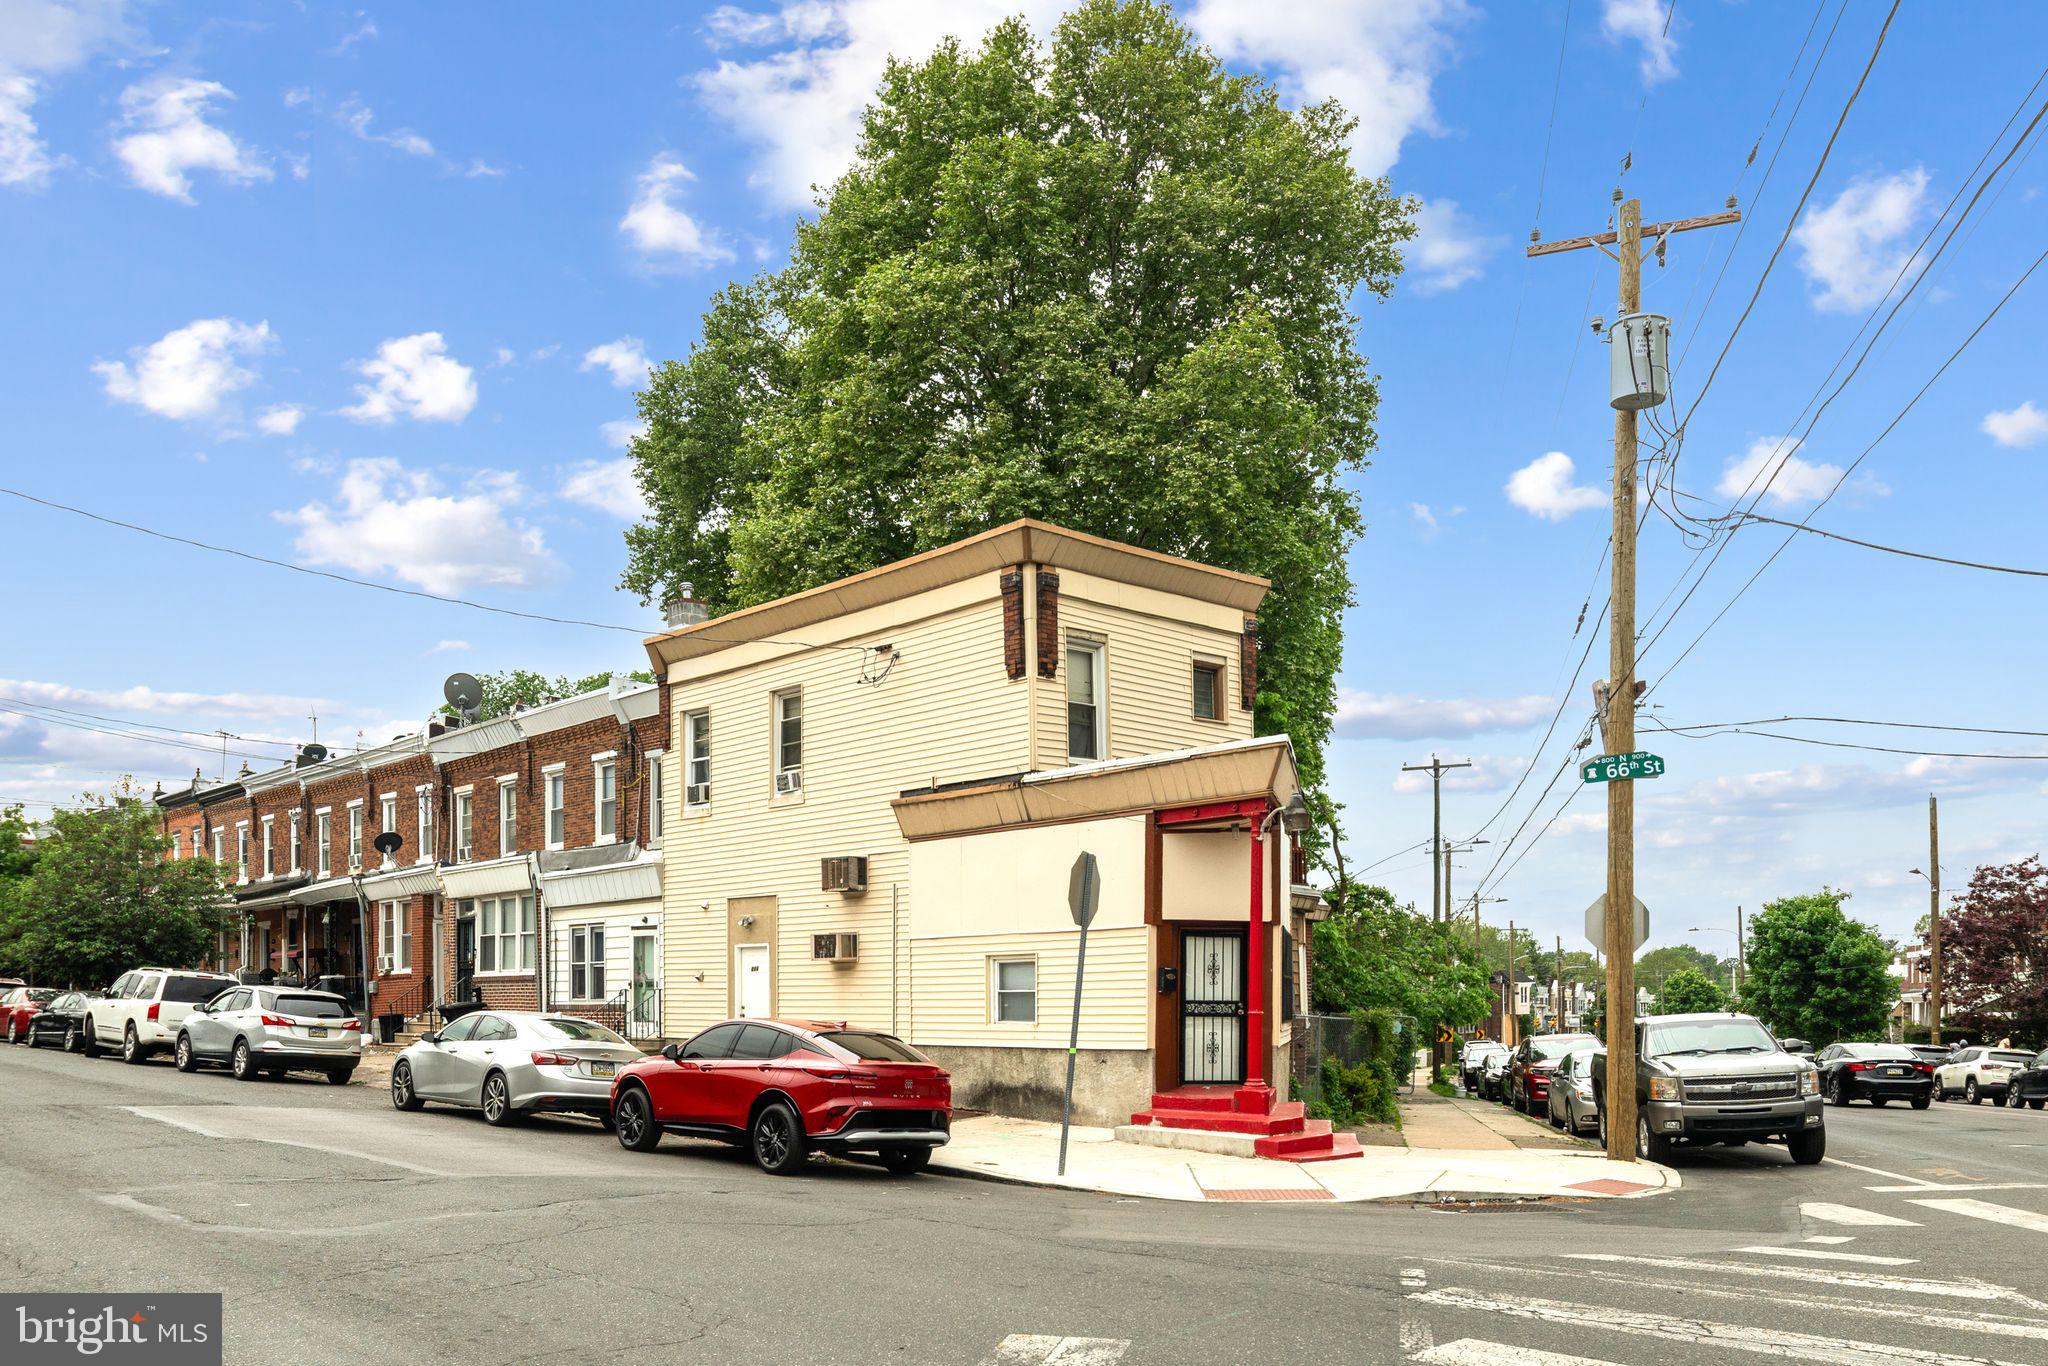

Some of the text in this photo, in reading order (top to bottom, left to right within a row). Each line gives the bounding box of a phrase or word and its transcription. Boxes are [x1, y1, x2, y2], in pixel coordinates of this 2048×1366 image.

[1619, 754, 1627, 762] N
[1606, 760, 1662, 778] 66th St
